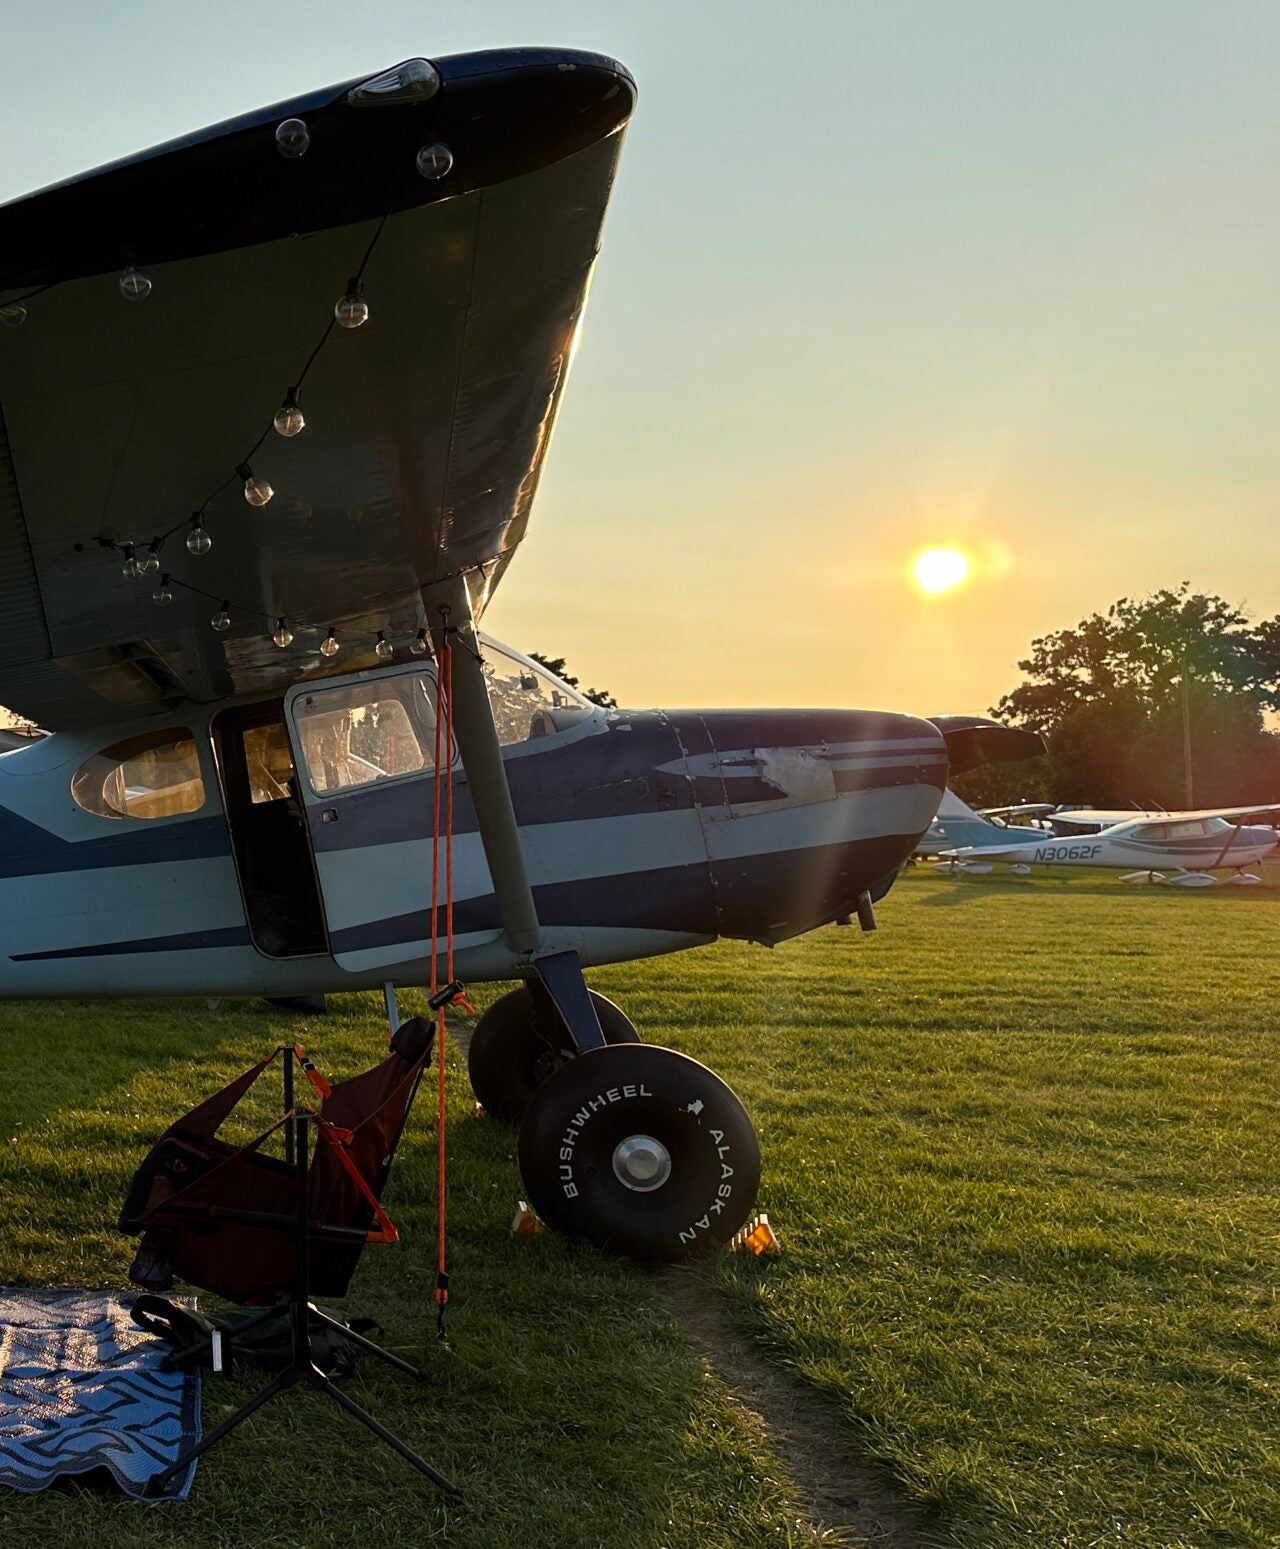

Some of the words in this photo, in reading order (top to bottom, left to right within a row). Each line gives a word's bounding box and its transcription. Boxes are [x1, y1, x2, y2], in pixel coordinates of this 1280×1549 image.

[1034, 844, 1102, 862] N3062F
[559, 1084, 653, 1199] BUSHWHEEL
[678, 1128, 734, 1244] ALASKAN
